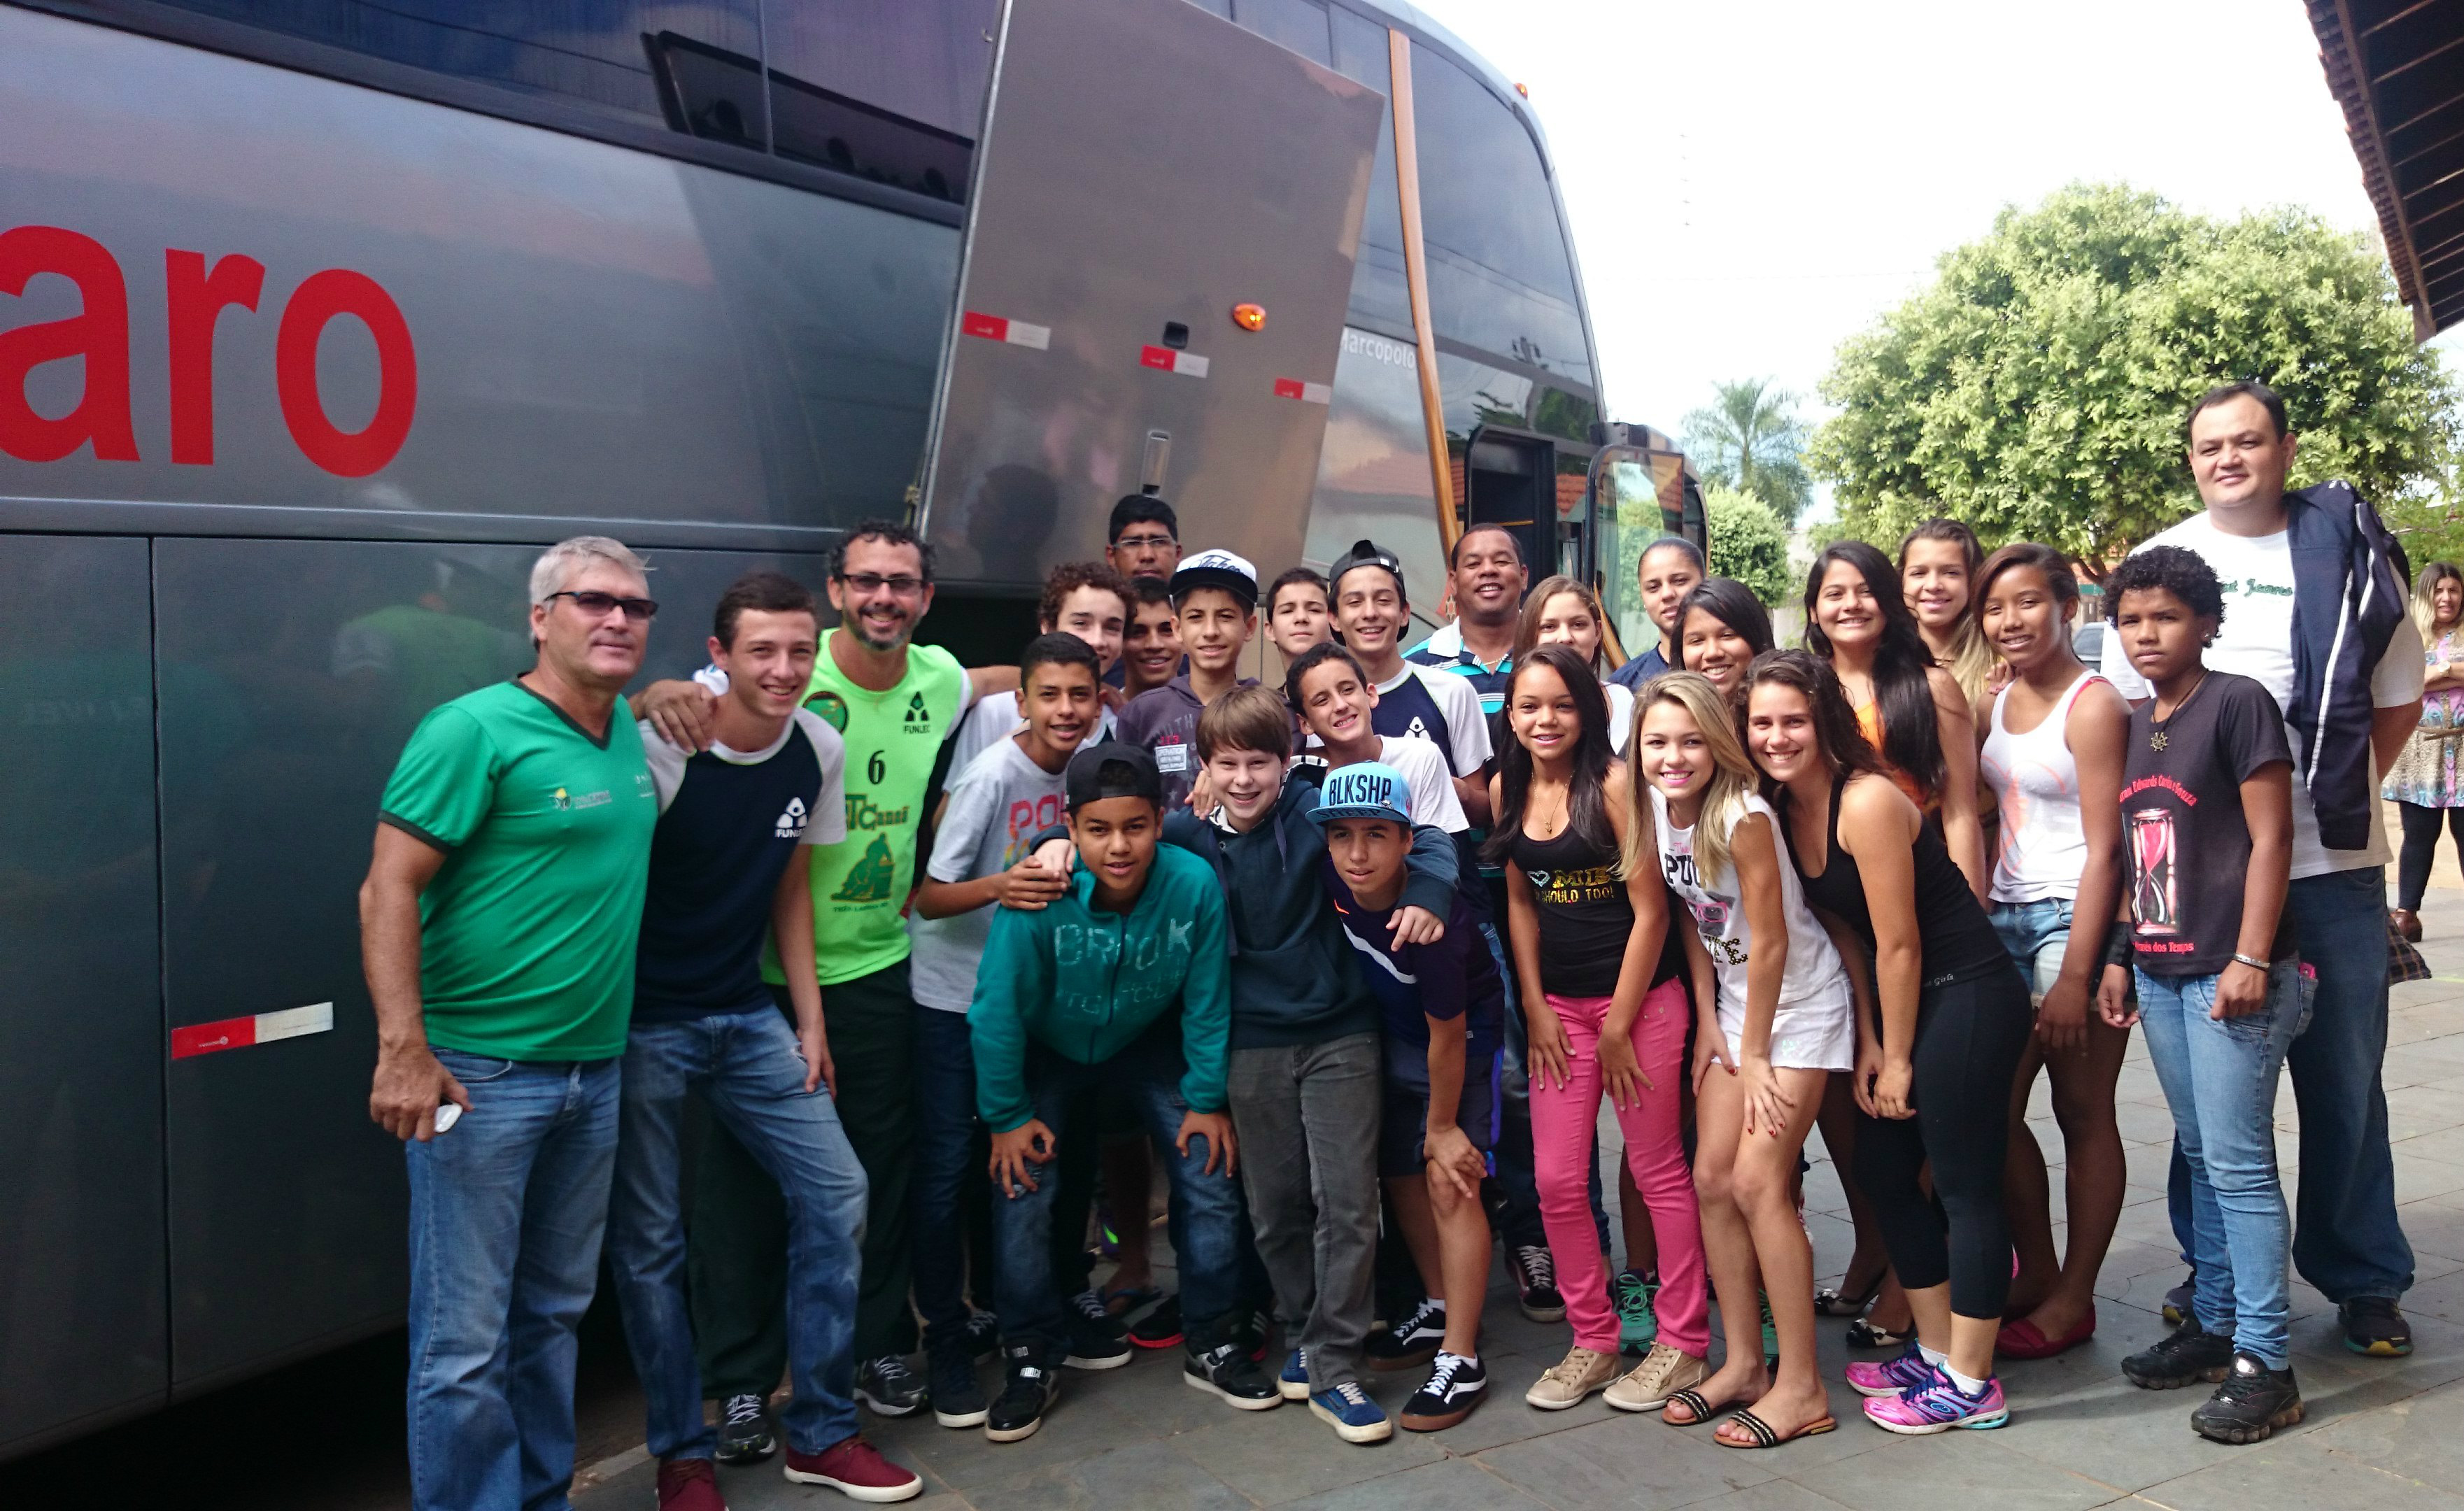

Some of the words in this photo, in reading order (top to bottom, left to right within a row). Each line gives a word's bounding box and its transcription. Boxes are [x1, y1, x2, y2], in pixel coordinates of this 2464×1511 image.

[0, 225, 417, 478] aro
[868, 750, 886, 785] 6
[1329, 774, 1392, 807] BLKSHP
[1585, 884, 1614, 902] TOO!
[2152, 942, 2167, 952] dos
